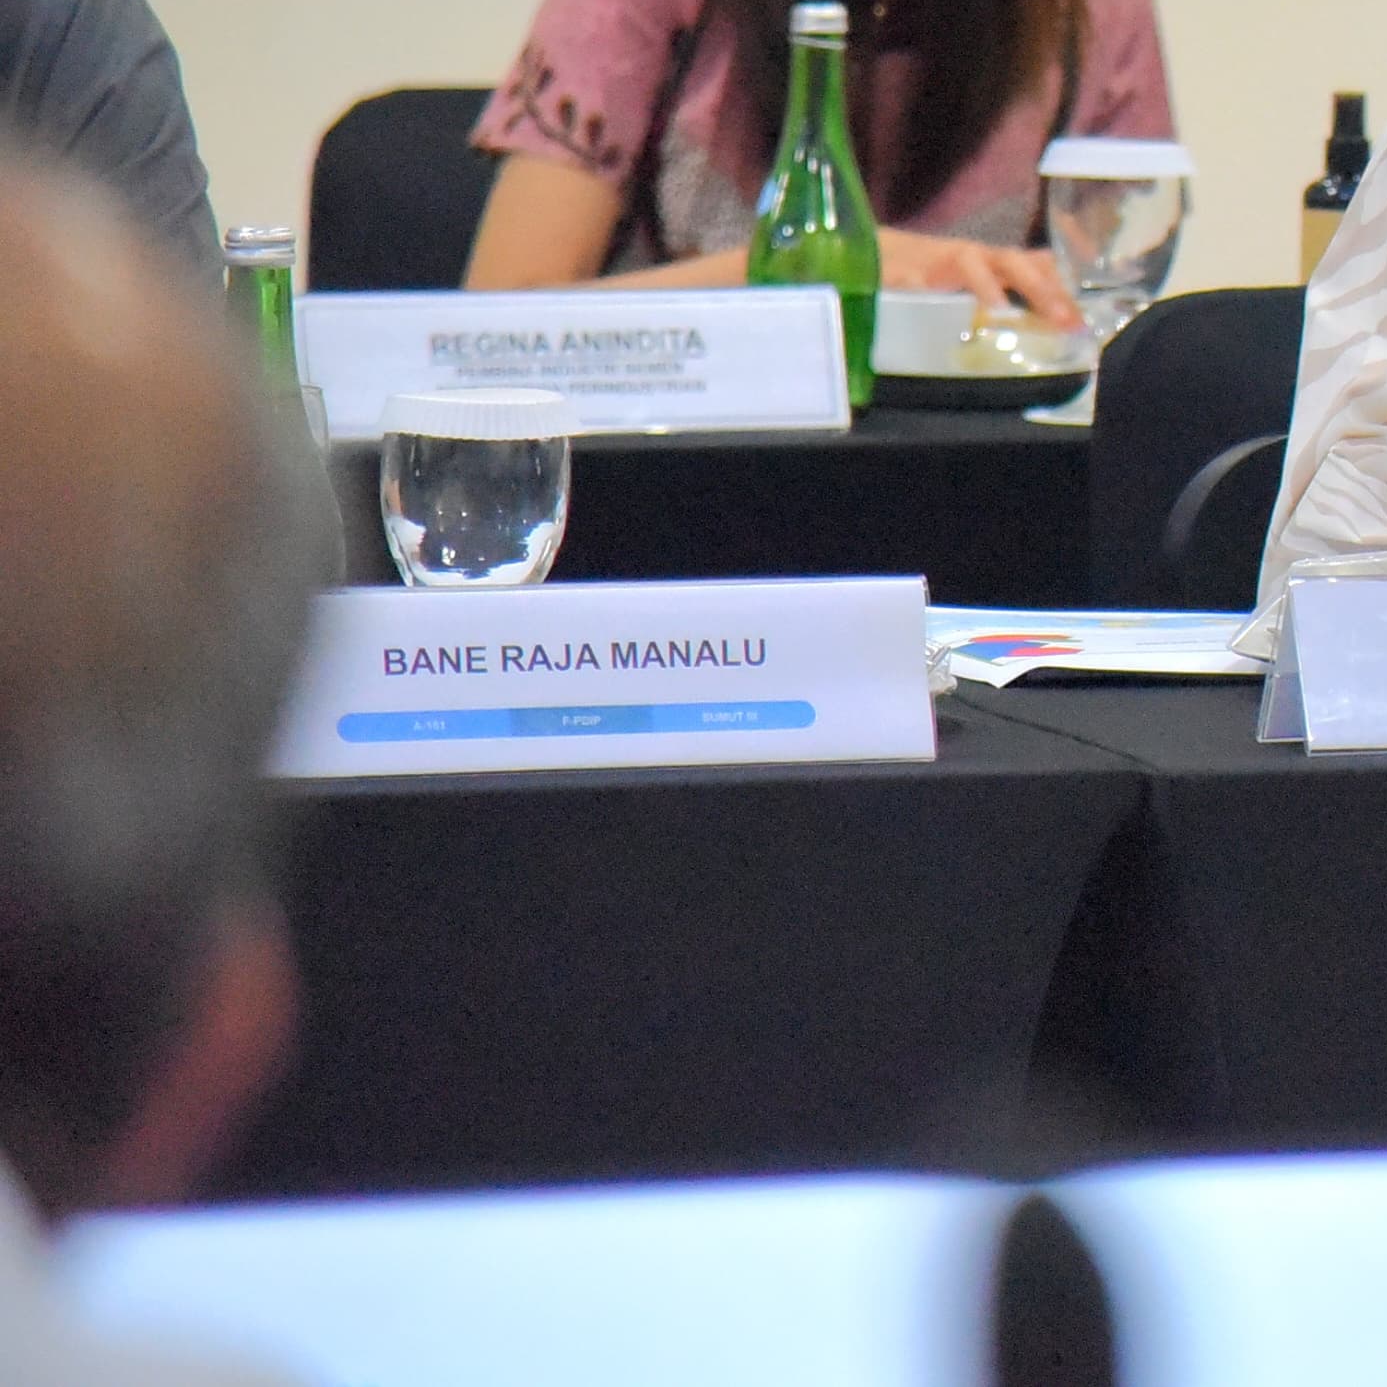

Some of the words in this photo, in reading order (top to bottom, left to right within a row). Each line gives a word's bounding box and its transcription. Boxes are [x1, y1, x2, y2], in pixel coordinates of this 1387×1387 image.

[431, 332, 550, 357] REGINA
[561, 329, 705, 355] ANINDITA
[383, 646, 488, 676] BANE
[501, 643, 601, 673] RAJA
[610, 638, 767, 670] MANALU
